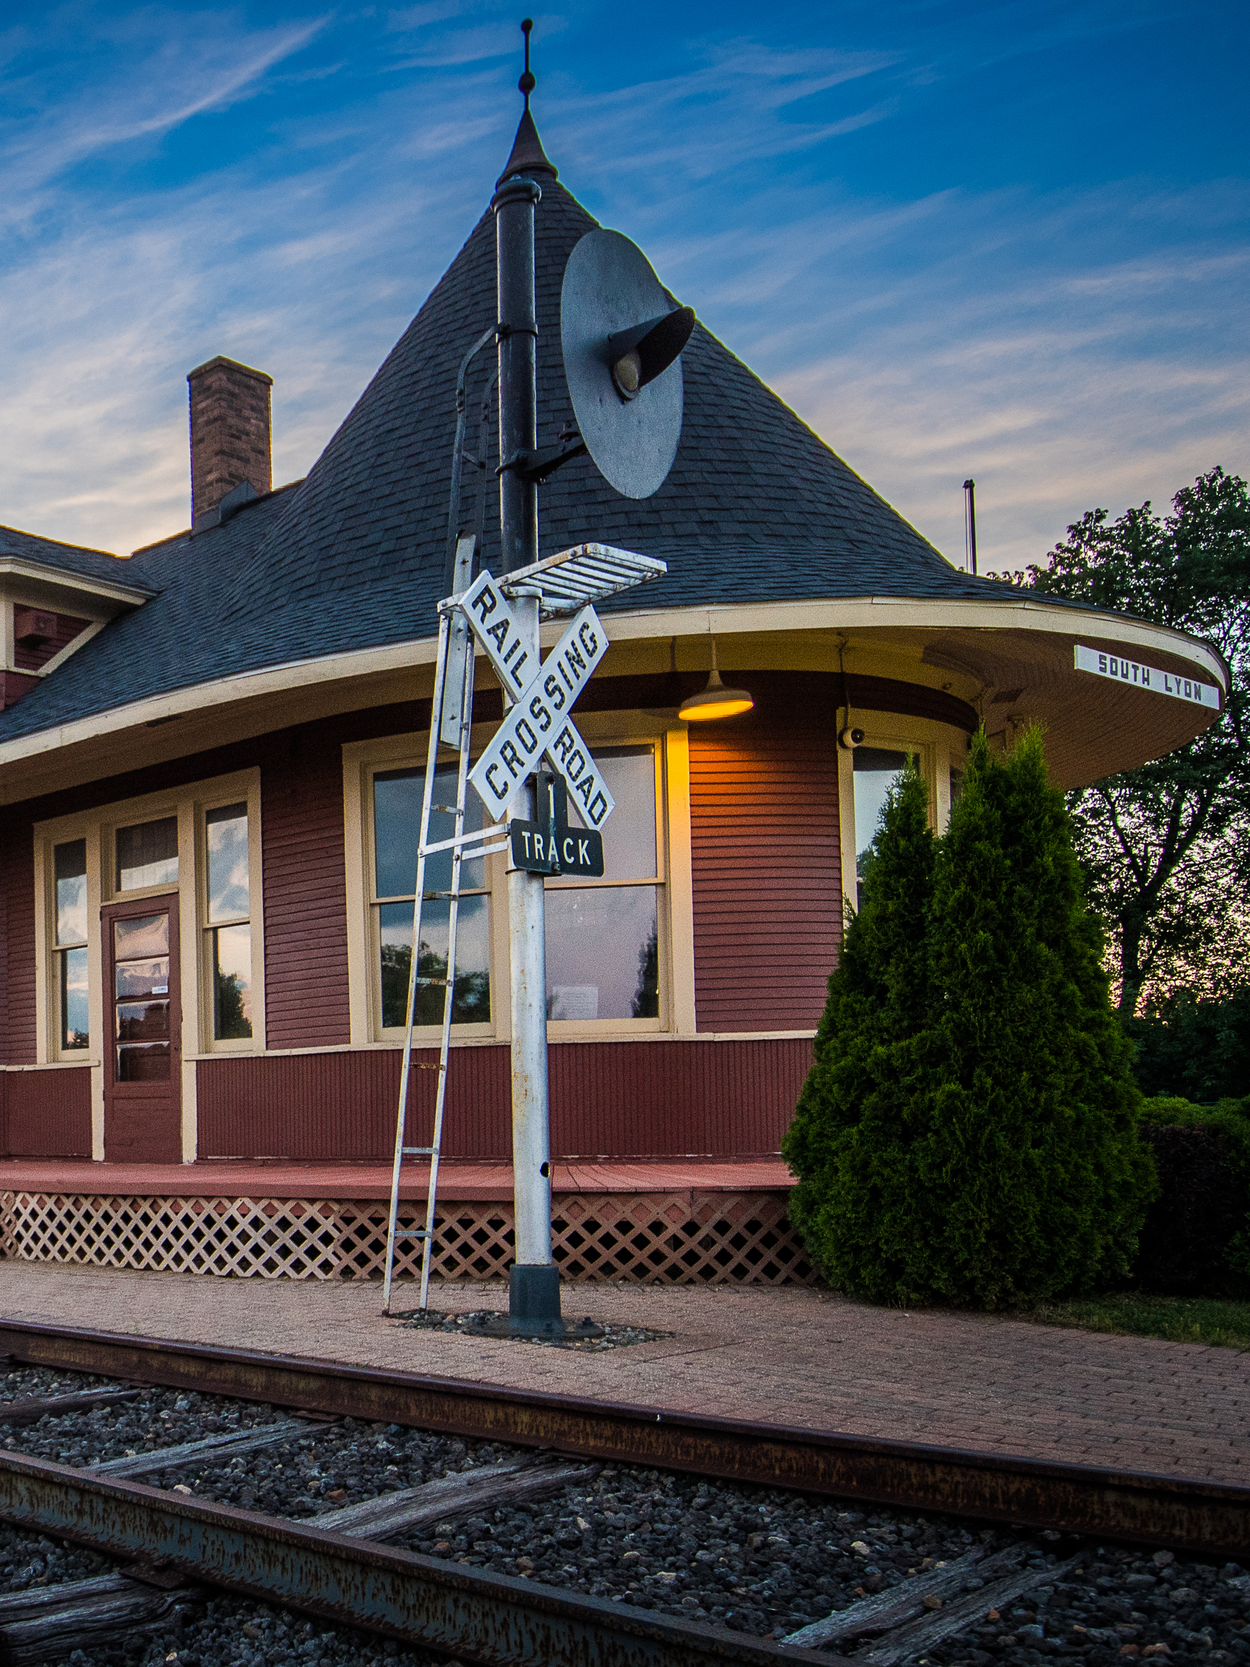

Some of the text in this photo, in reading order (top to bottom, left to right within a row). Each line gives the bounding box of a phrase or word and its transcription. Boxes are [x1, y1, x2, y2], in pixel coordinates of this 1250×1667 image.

[471, 583, 609, 826] RAIL ROAD
[485, 621, 600, 801] CROSSING
[1098, 653, 1202, 701] SOUTH LYON
[521, 831, 592, 866] TRACK
